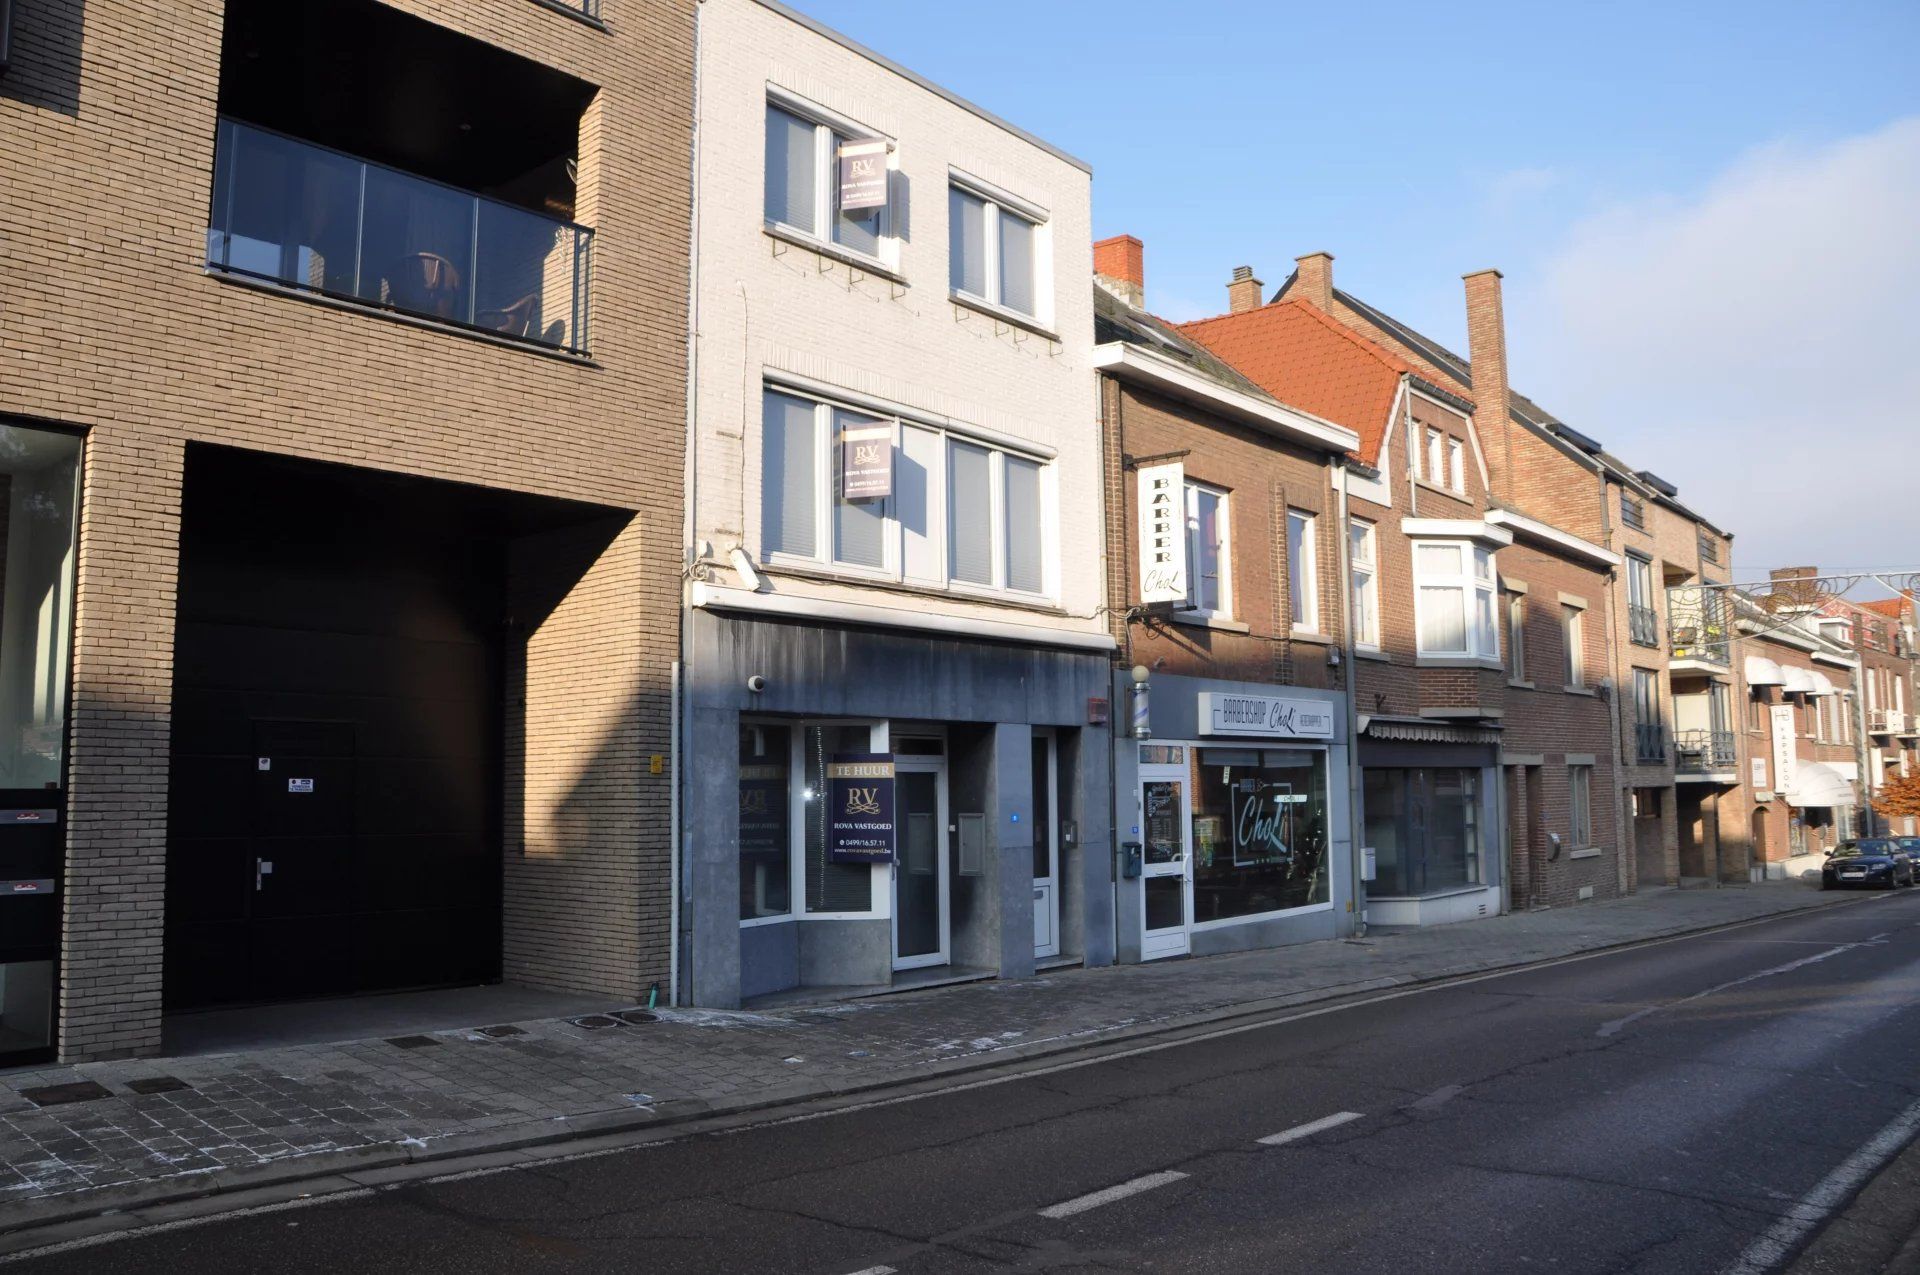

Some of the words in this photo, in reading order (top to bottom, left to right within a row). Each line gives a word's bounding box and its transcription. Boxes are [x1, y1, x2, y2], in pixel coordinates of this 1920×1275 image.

[1151, 478, 1172, 564] BARBER
[1223, 698, 1267, 725] BARBERSHOP
[836, 766, 850, 776] TE
[853, 765, 890, 776] HUUR
[847, 787, 879, 805] RV
